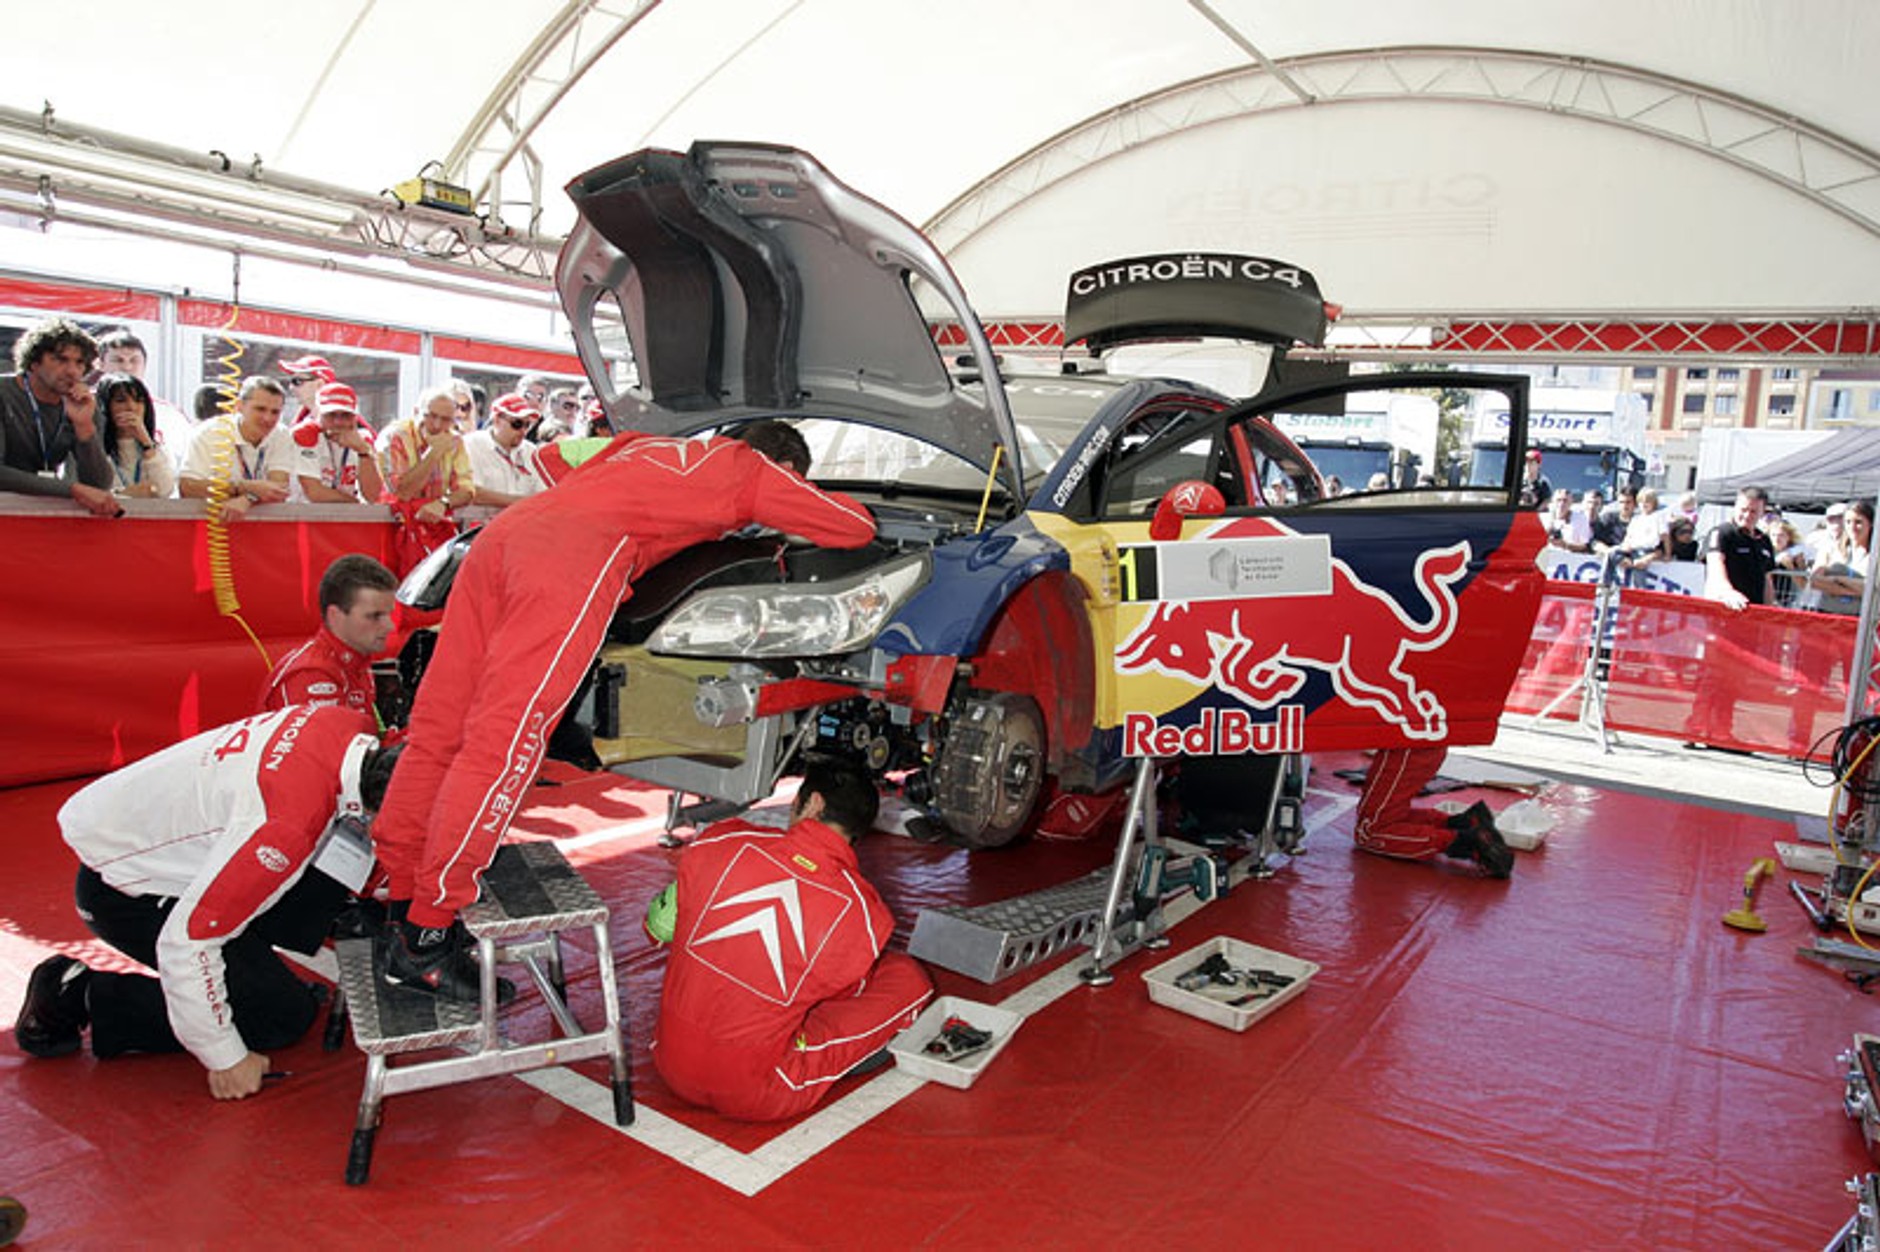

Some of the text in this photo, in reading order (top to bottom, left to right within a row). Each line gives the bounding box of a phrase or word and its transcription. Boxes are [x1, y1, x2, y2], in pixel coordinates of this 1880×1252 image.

[1072, 255, 1303, 296] CITROËN C4
[1495, 412, 1598, 431] Sobart
[1119, 547, 1137, 601] 1
[1124, 705, 1305, 757] Red Bull
